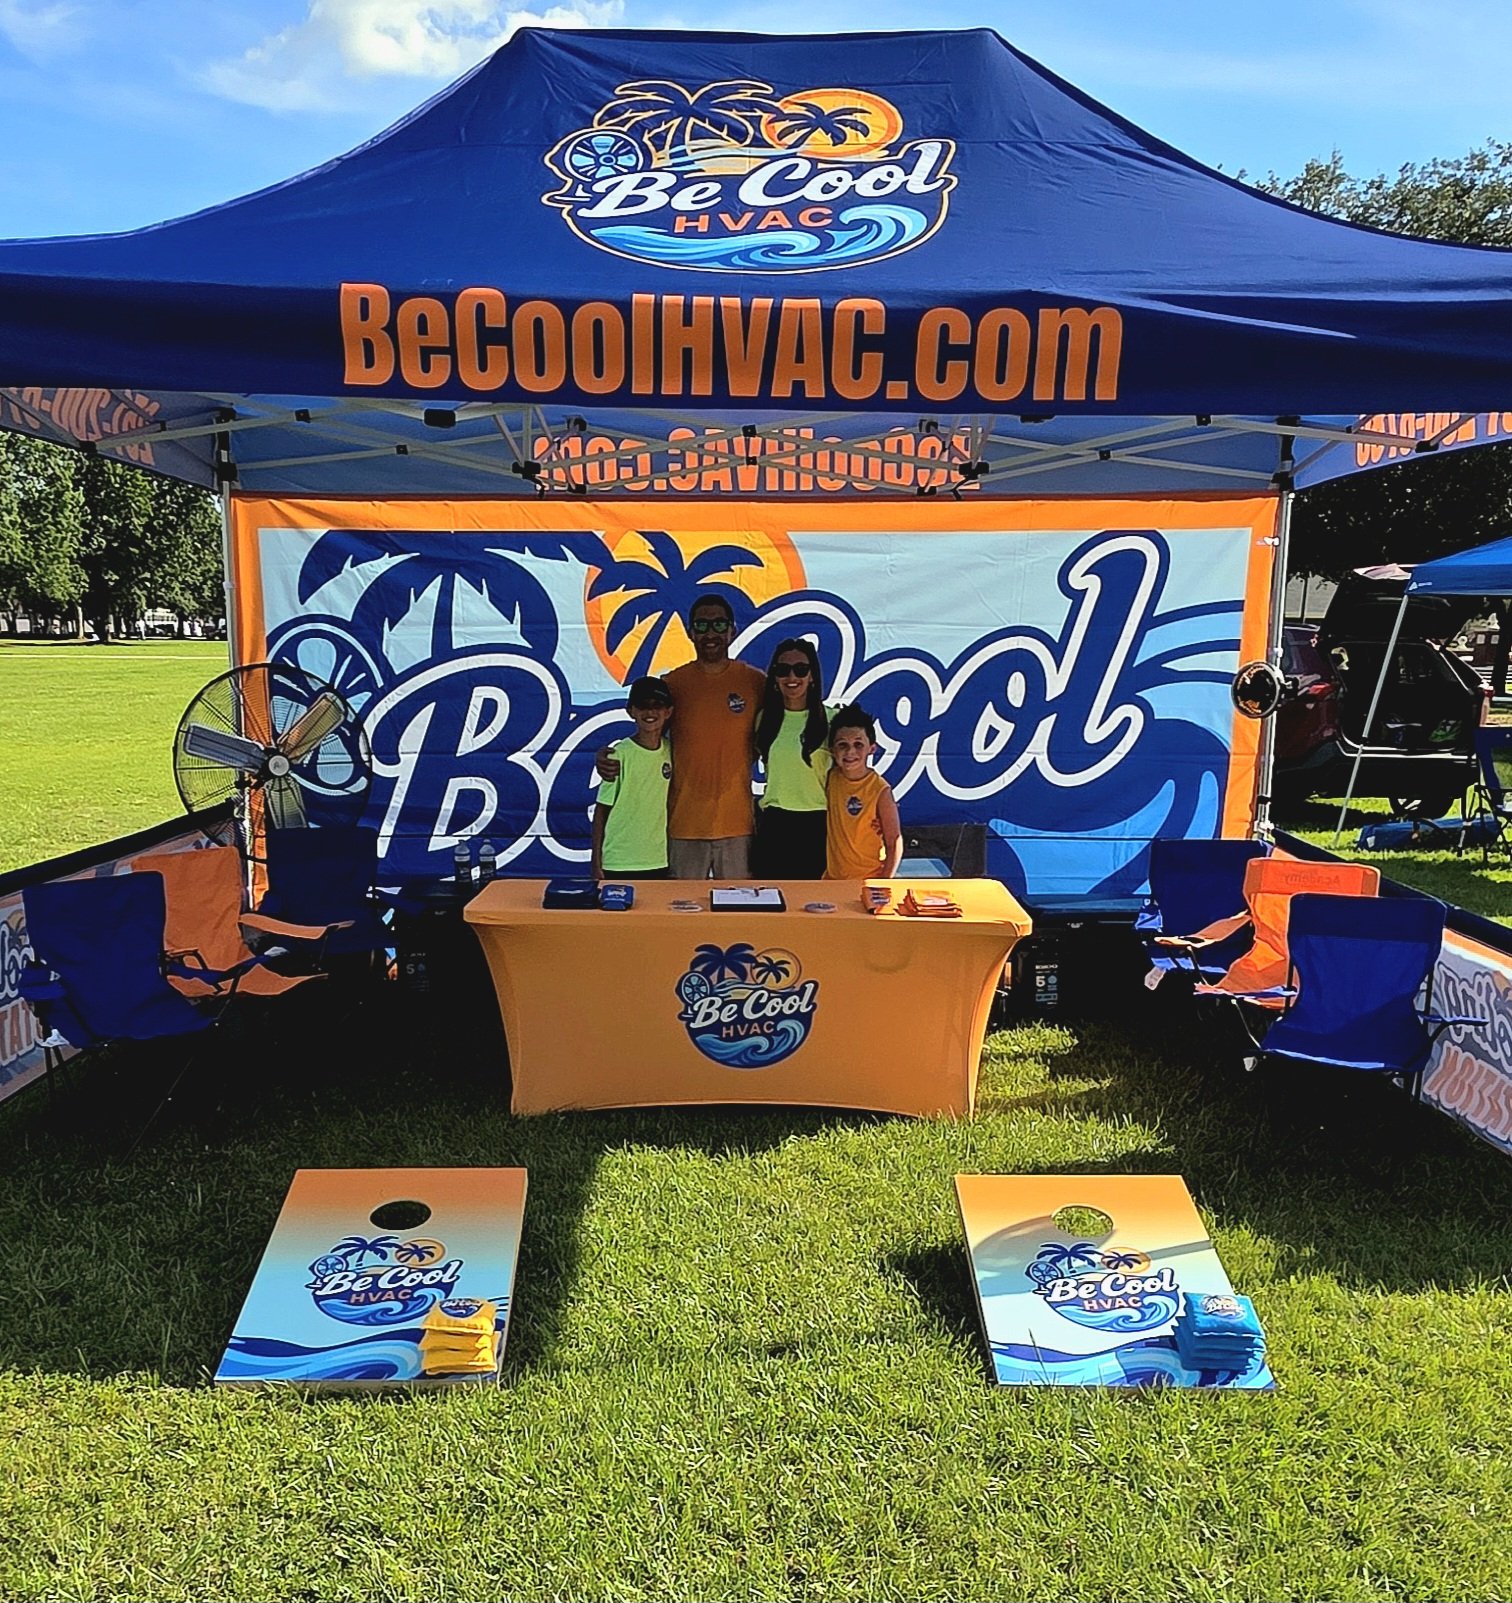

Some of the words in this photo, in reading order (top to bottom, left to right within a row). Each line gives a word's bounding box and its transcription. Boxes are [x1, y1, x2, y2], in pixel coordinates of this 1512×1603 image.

[578, 171, 722, 218] Be
[738, 140, 947, 209] Cool
[674, 206, 833, 234] HVAC
[340, 283, 1123, 401] BeCoolHVAC.com
[1035, 975, 1046, 987] 5
[690, 996, 738, 1029] Be
[743, 982, 815, 1020] Cool
[722, 1020, 775, 1038] HVAC
[314, 1271, 373, 1296] Be
[377, 1260, 458, 1289] Cool
[1045, 1276, 1098, 1302] Be
[1101, 1267, 1179, 1297] Cool
[350, 1288, 413, 1304] HVAC
[1083, 1296, 1144, 1311] HVAC
